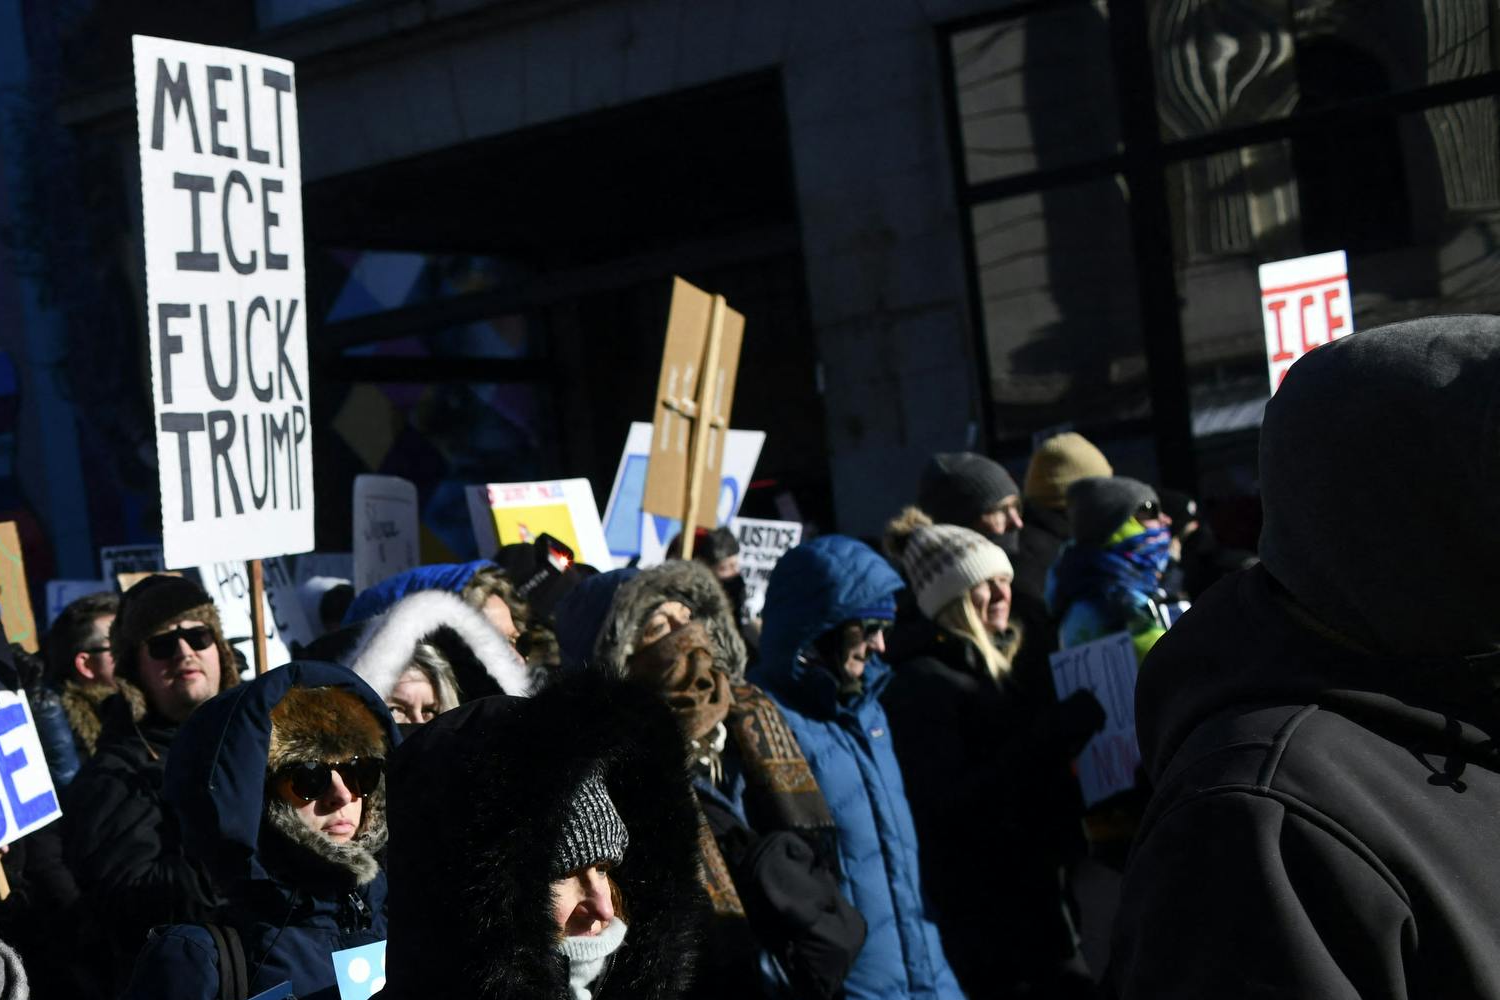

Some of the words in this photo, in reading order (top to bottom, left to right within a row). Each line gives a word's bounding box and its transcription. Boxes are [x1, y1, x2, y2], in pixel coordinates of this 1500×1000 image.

[151, 57, 291, 169] MELT
[173, 170, 289, 275] ICE
[157, 295, 303, 404] FUCK
[160, 405, 306, 522] TRUMP
